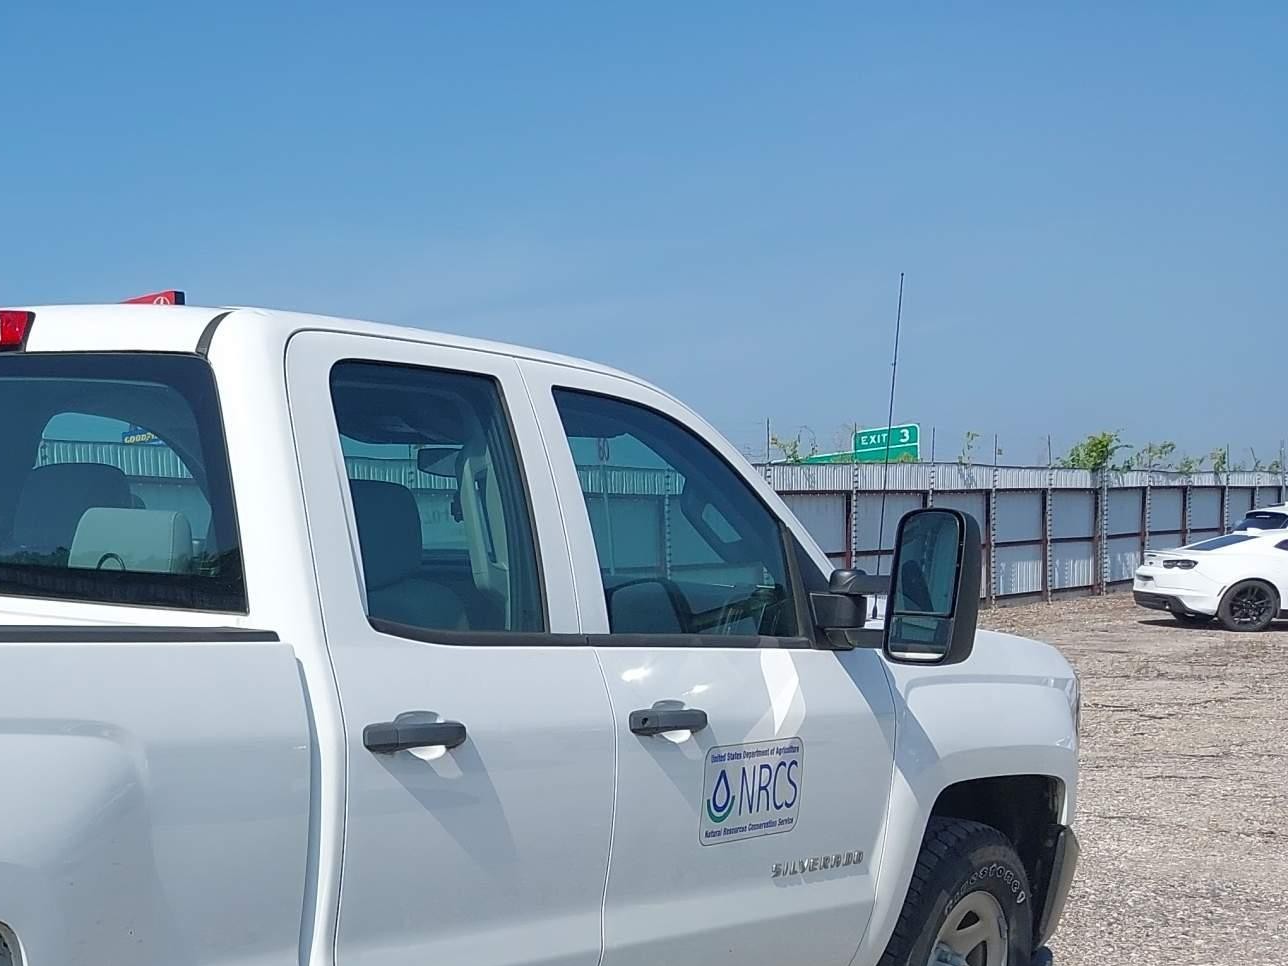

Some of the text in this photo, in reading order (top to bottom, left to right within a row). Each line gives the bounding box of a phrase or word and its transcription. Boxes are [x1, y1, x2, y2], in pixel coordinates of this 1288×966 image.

[861, 428, 910, 446] EXIT 3
[727, 751, 742, 761] States
[743, 748, 769, 760] Department
[738, 759, 799, 816] NRCS
[705, 829, 722, 839] Natural
[748, 819, 777, 832] Conservation
[778, 817, 794, 827] Service
[771, 850, 864, 879] SILVERADO
